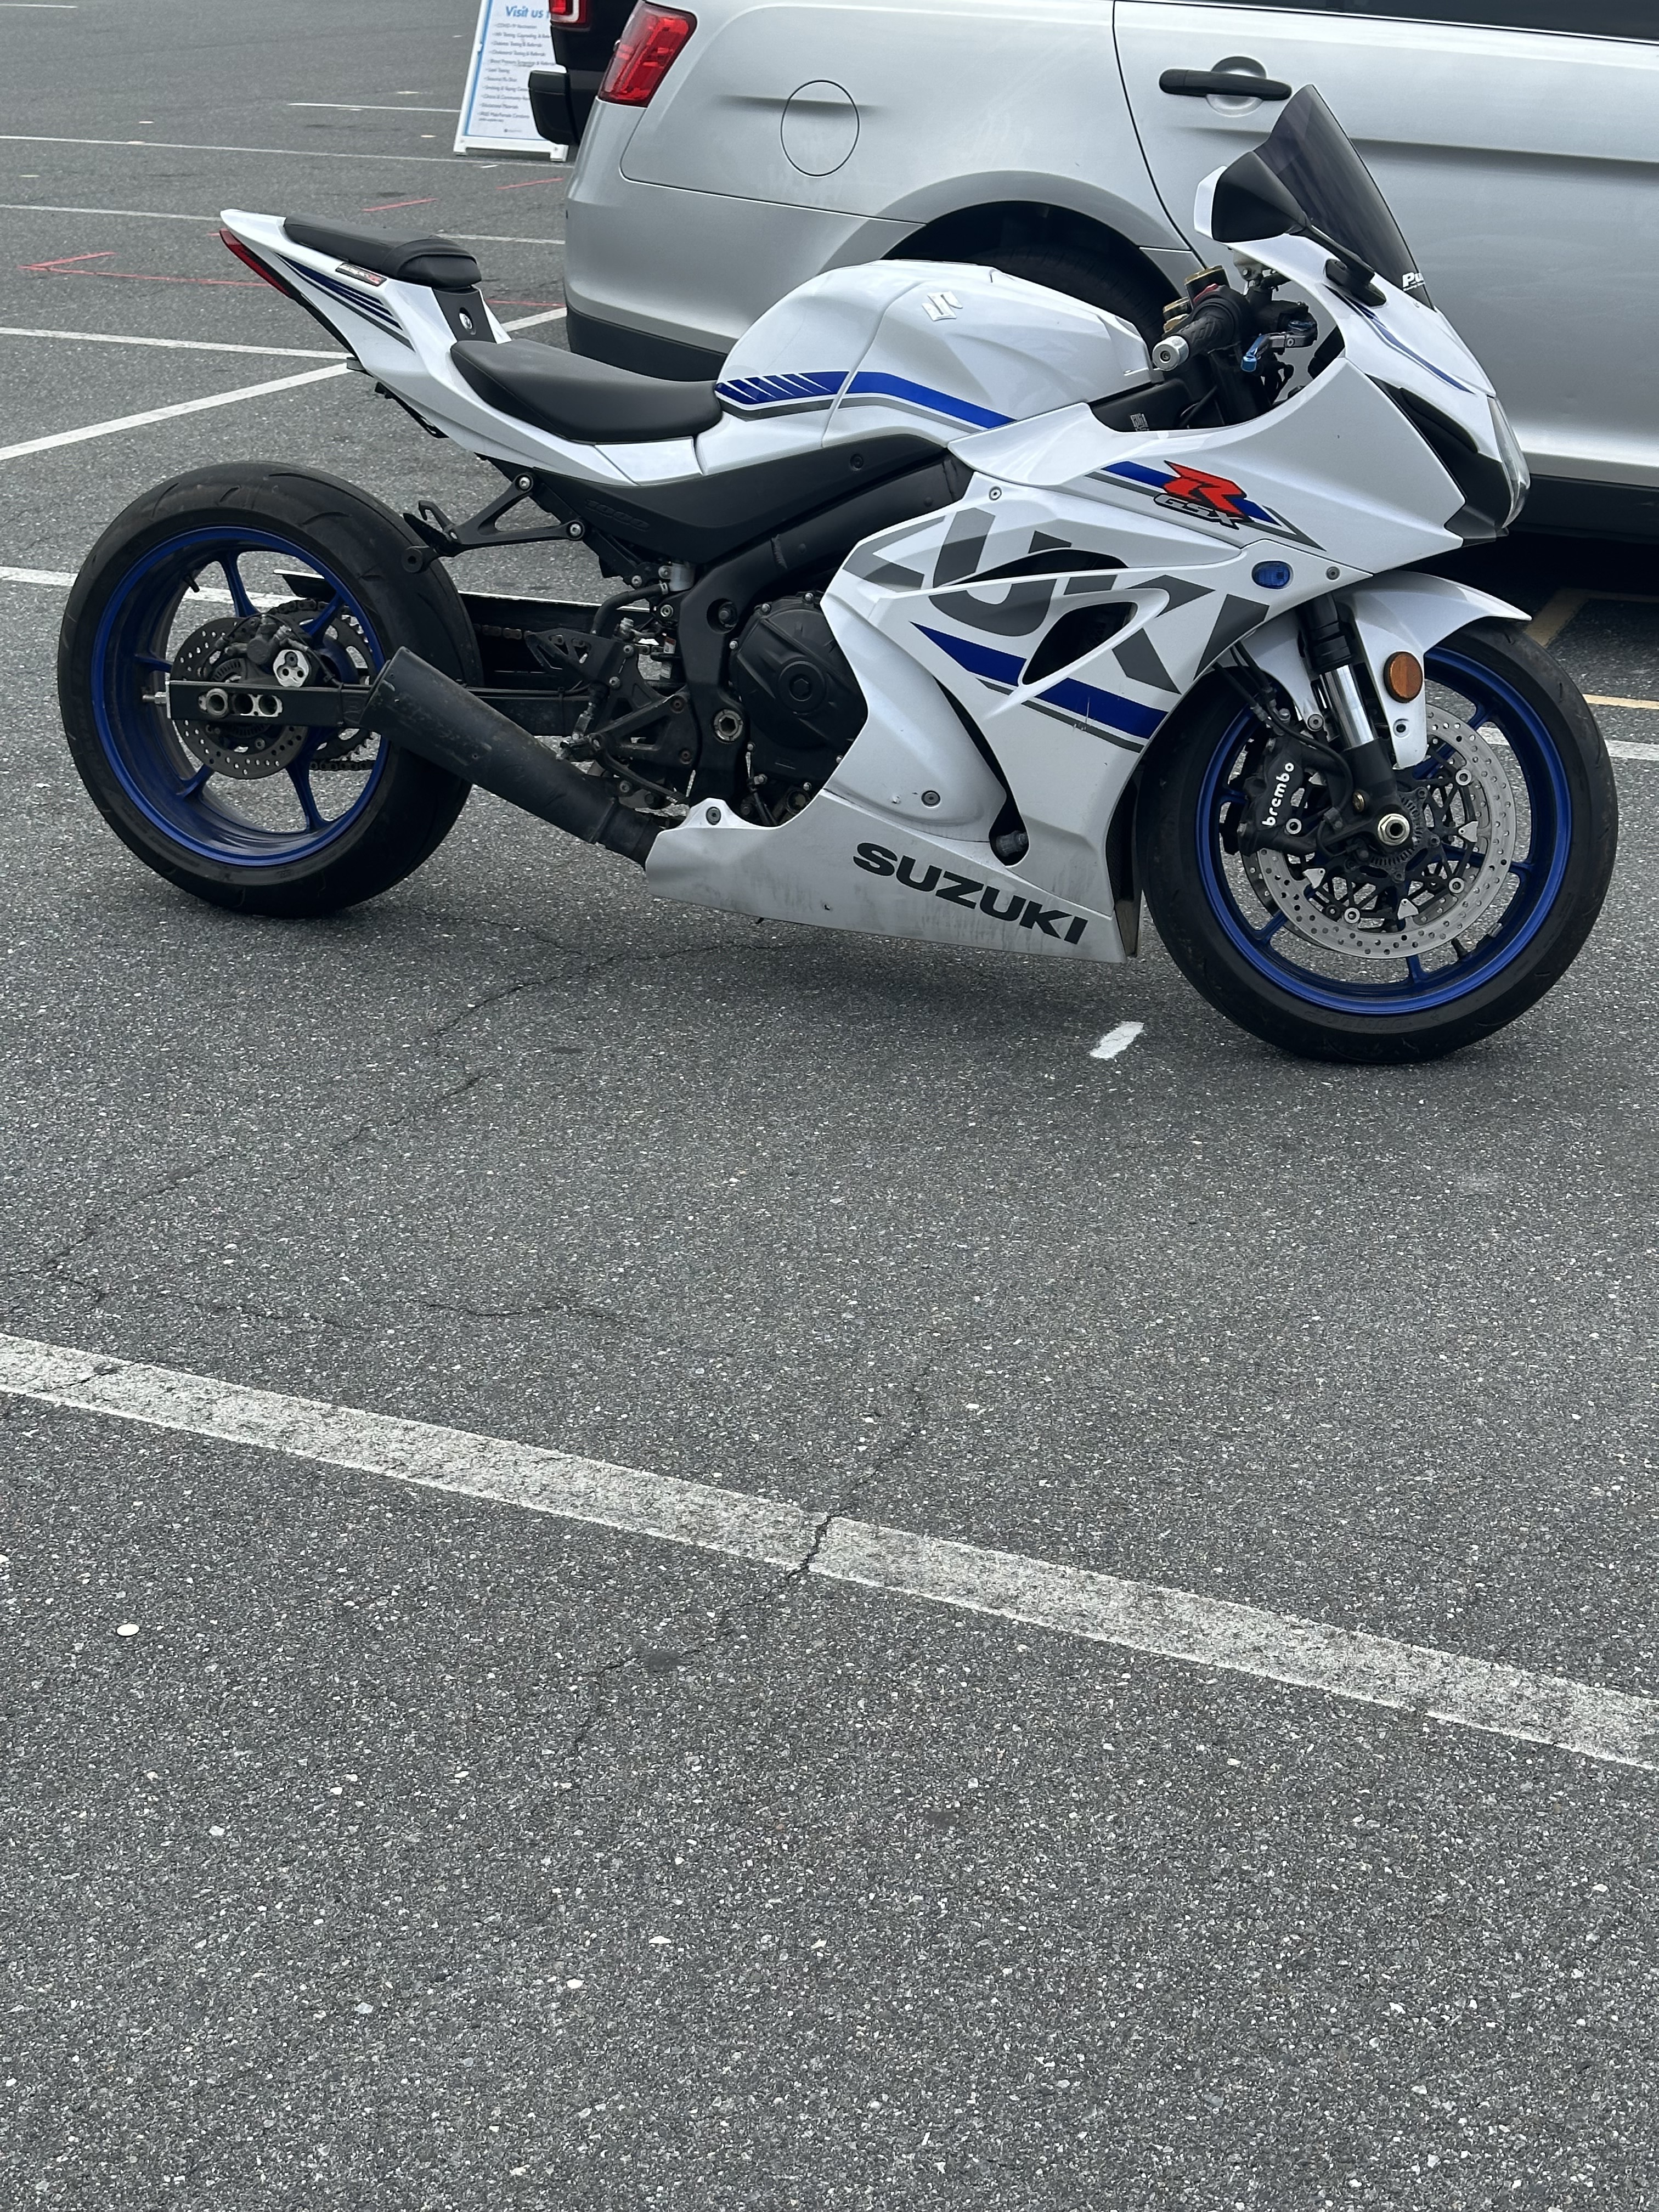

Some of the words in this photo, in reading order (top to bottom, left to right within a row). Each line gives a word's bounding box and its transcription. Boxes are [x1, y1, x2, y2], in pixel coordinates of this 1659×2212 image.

[506, 5, 528, 18] Visit
[531, 10, 544, 18] us
[585, 499, 650, 532] 1000
[1262, 763, 1294, 826] brembo
[853, 842, 1088, 945] SUZUKI
